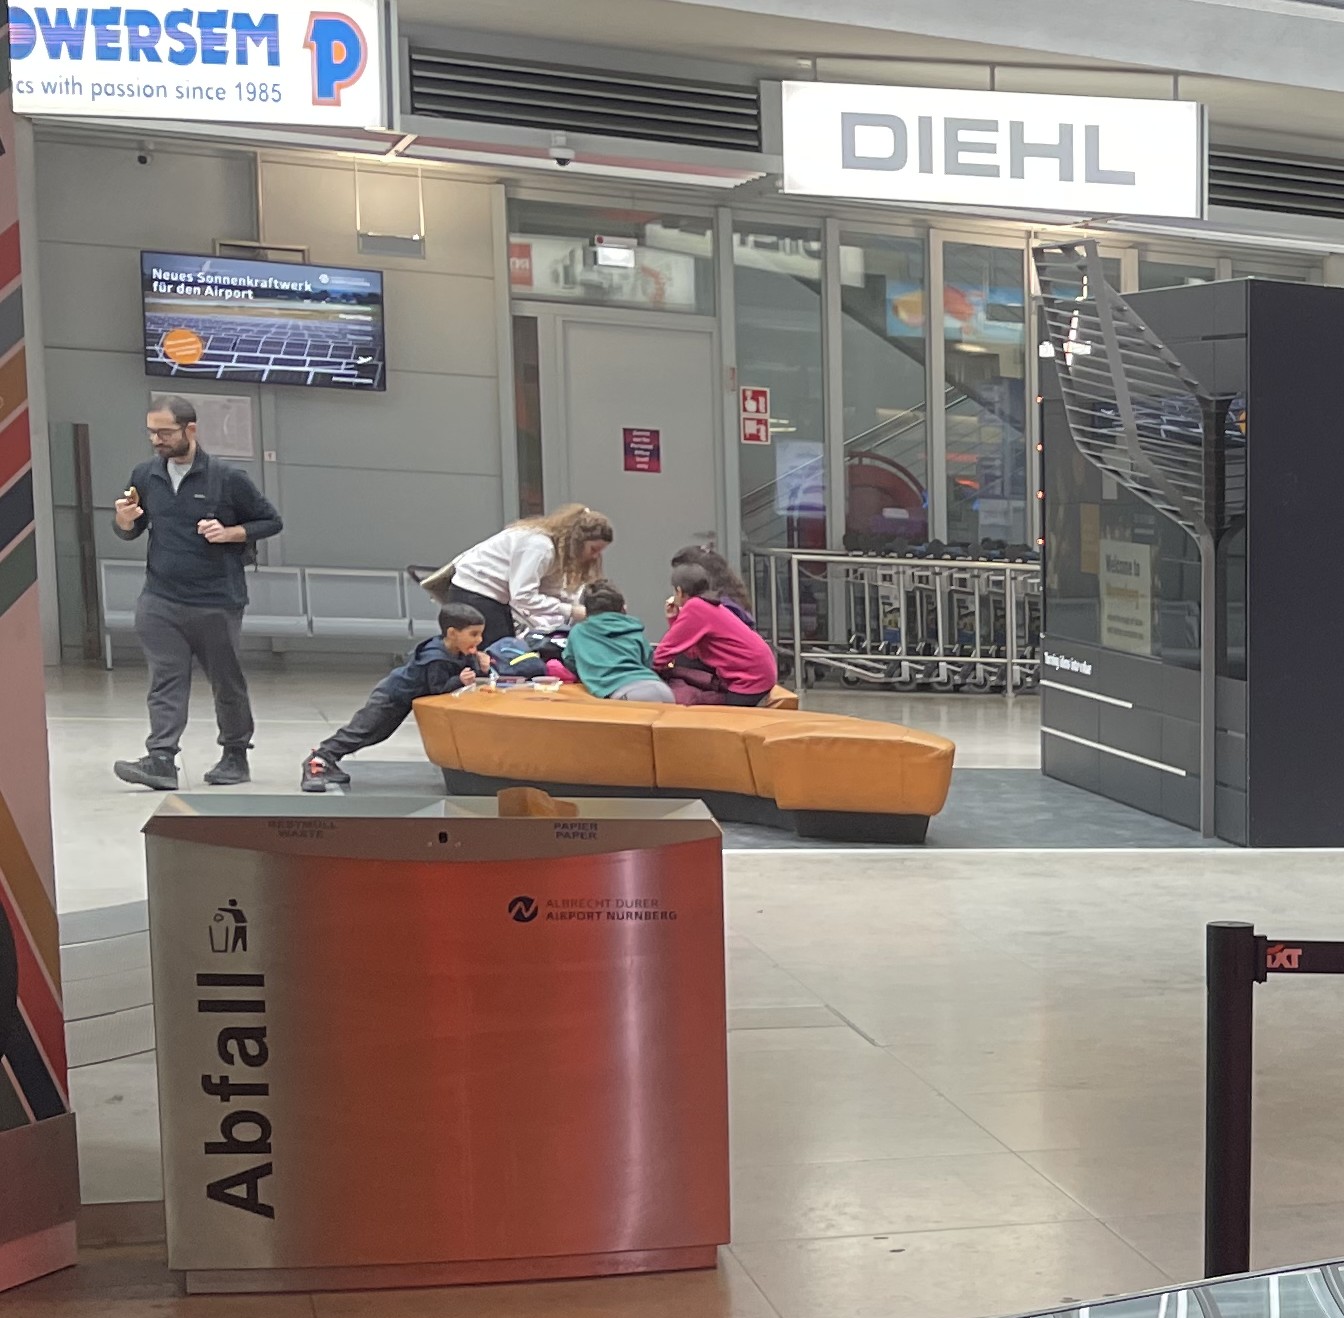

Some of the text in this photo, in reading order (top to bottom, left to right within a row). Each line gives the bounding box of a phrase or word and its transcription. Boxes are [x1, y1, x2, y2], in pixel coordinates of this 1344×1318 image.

[41, 75, 83, 96] with
[91, 77, 168, 102] passion
[175, 80, 227, 102] since
[234, 82, 282, 103] 1985
[840, 111, 1136, 187] DIEHL
[152, 268, 194, 283] Neues
[197, 274, 313, 292] Sonnenkraftwerk
[152, 281, 254, 300] für den Airport
[554, 822, 598, 831] PAPIER
[555, 831, 598, 840] PAPER
[546, 899, 611, 909] ALBRECHT
[546, 911, 601, 921] AIRPORT
[1266, 944, 1303, 969] IXT
[195, 972, 276, 1221] Abfall
